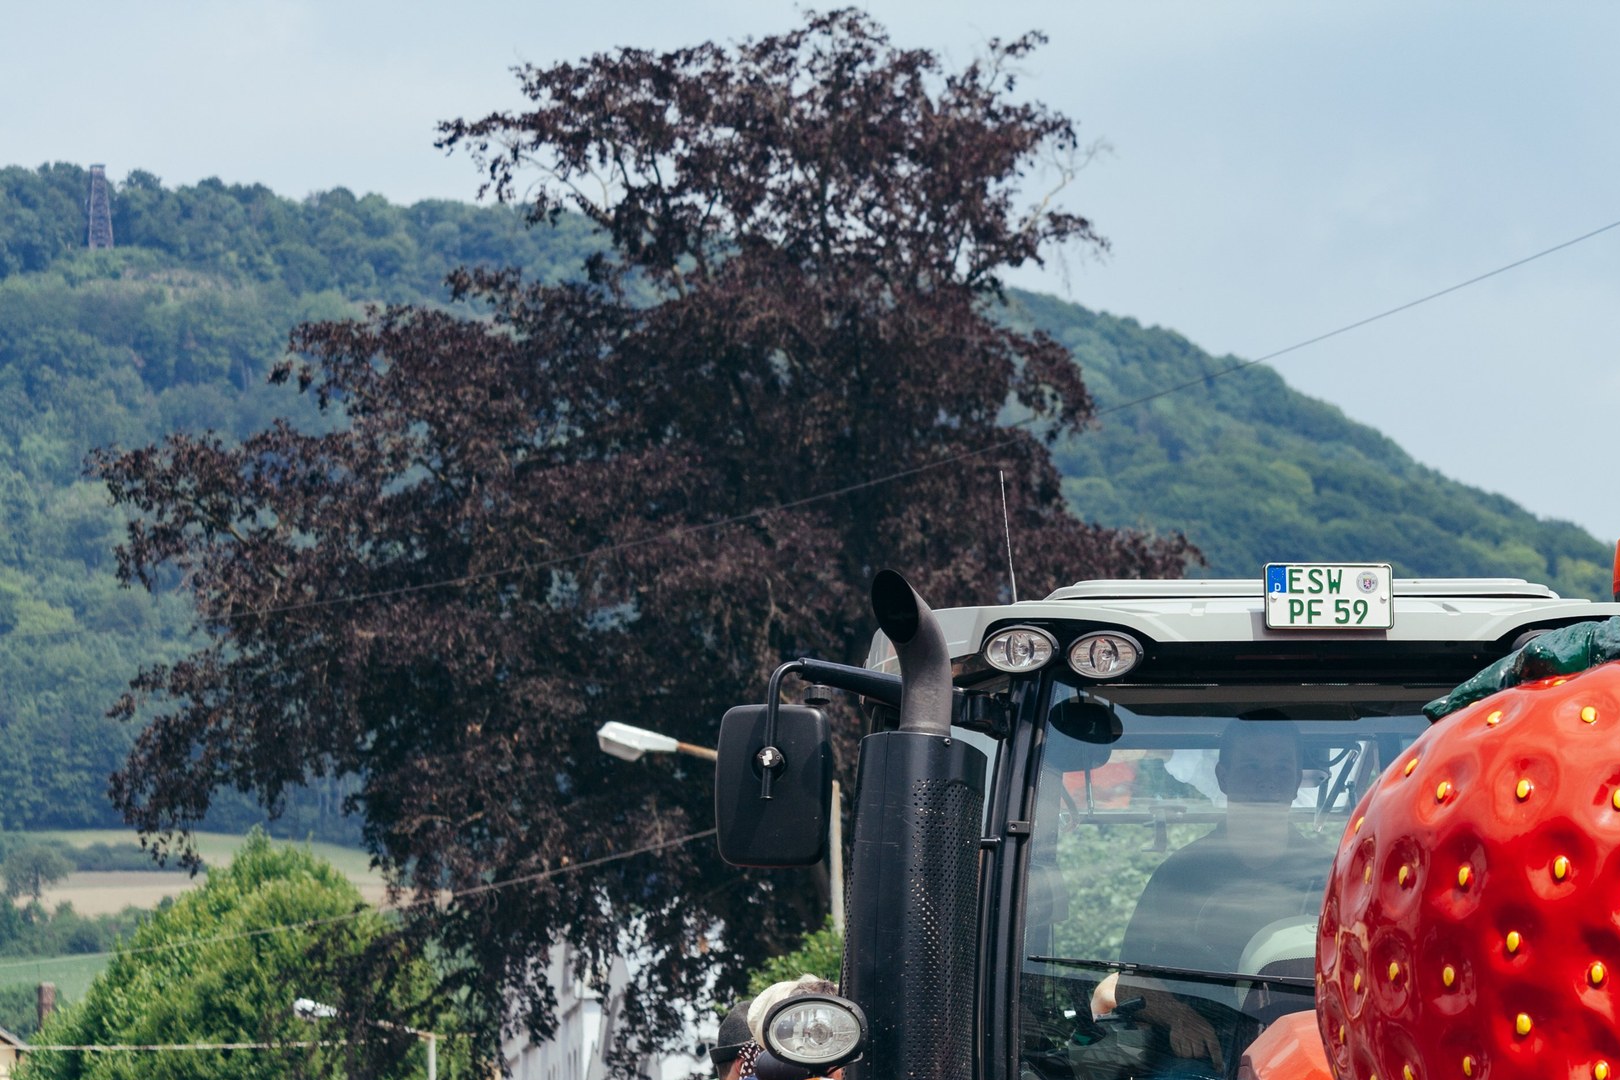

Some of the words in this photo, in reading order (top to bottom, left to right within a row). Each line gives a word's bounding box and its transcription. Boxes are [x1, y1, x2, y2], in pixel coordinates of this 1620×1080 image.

[1274, 582, 1282, 592] D
[1288, 568, 1343, 594] ESW
[1288, 598, 1324, 625] PF
[1334, 598, 1369, 625] 59
